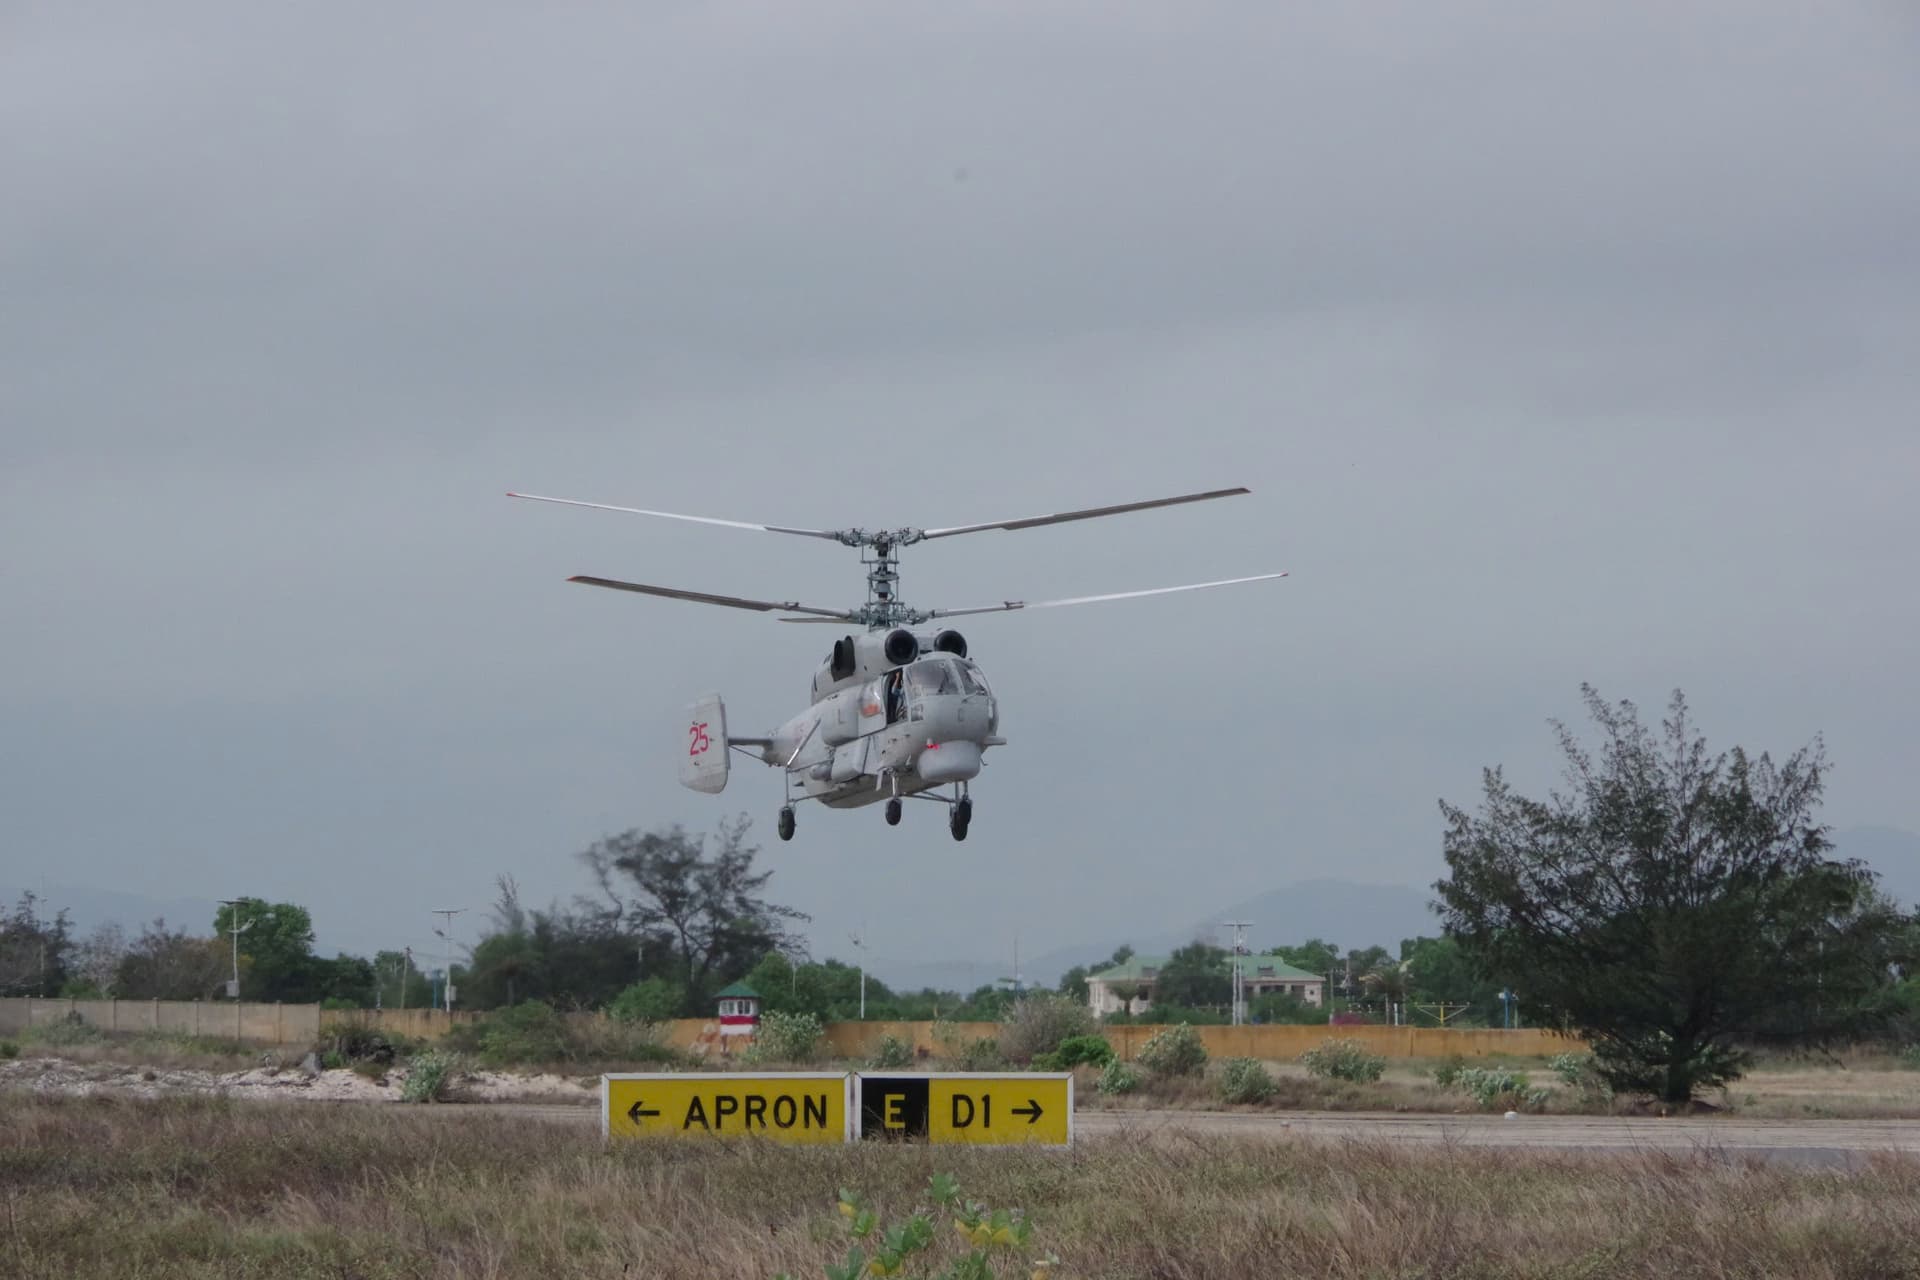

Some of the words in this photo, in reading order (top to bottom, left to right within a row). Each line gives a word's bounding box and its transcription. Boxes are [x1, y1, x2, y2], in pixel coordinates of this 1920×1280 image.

[689, 723, 709, 756] 25
[683, 1094, 827, 1129] APRON
[884, 1093, 905, 1129] E
[952, 1094, 991, 1129] D1
